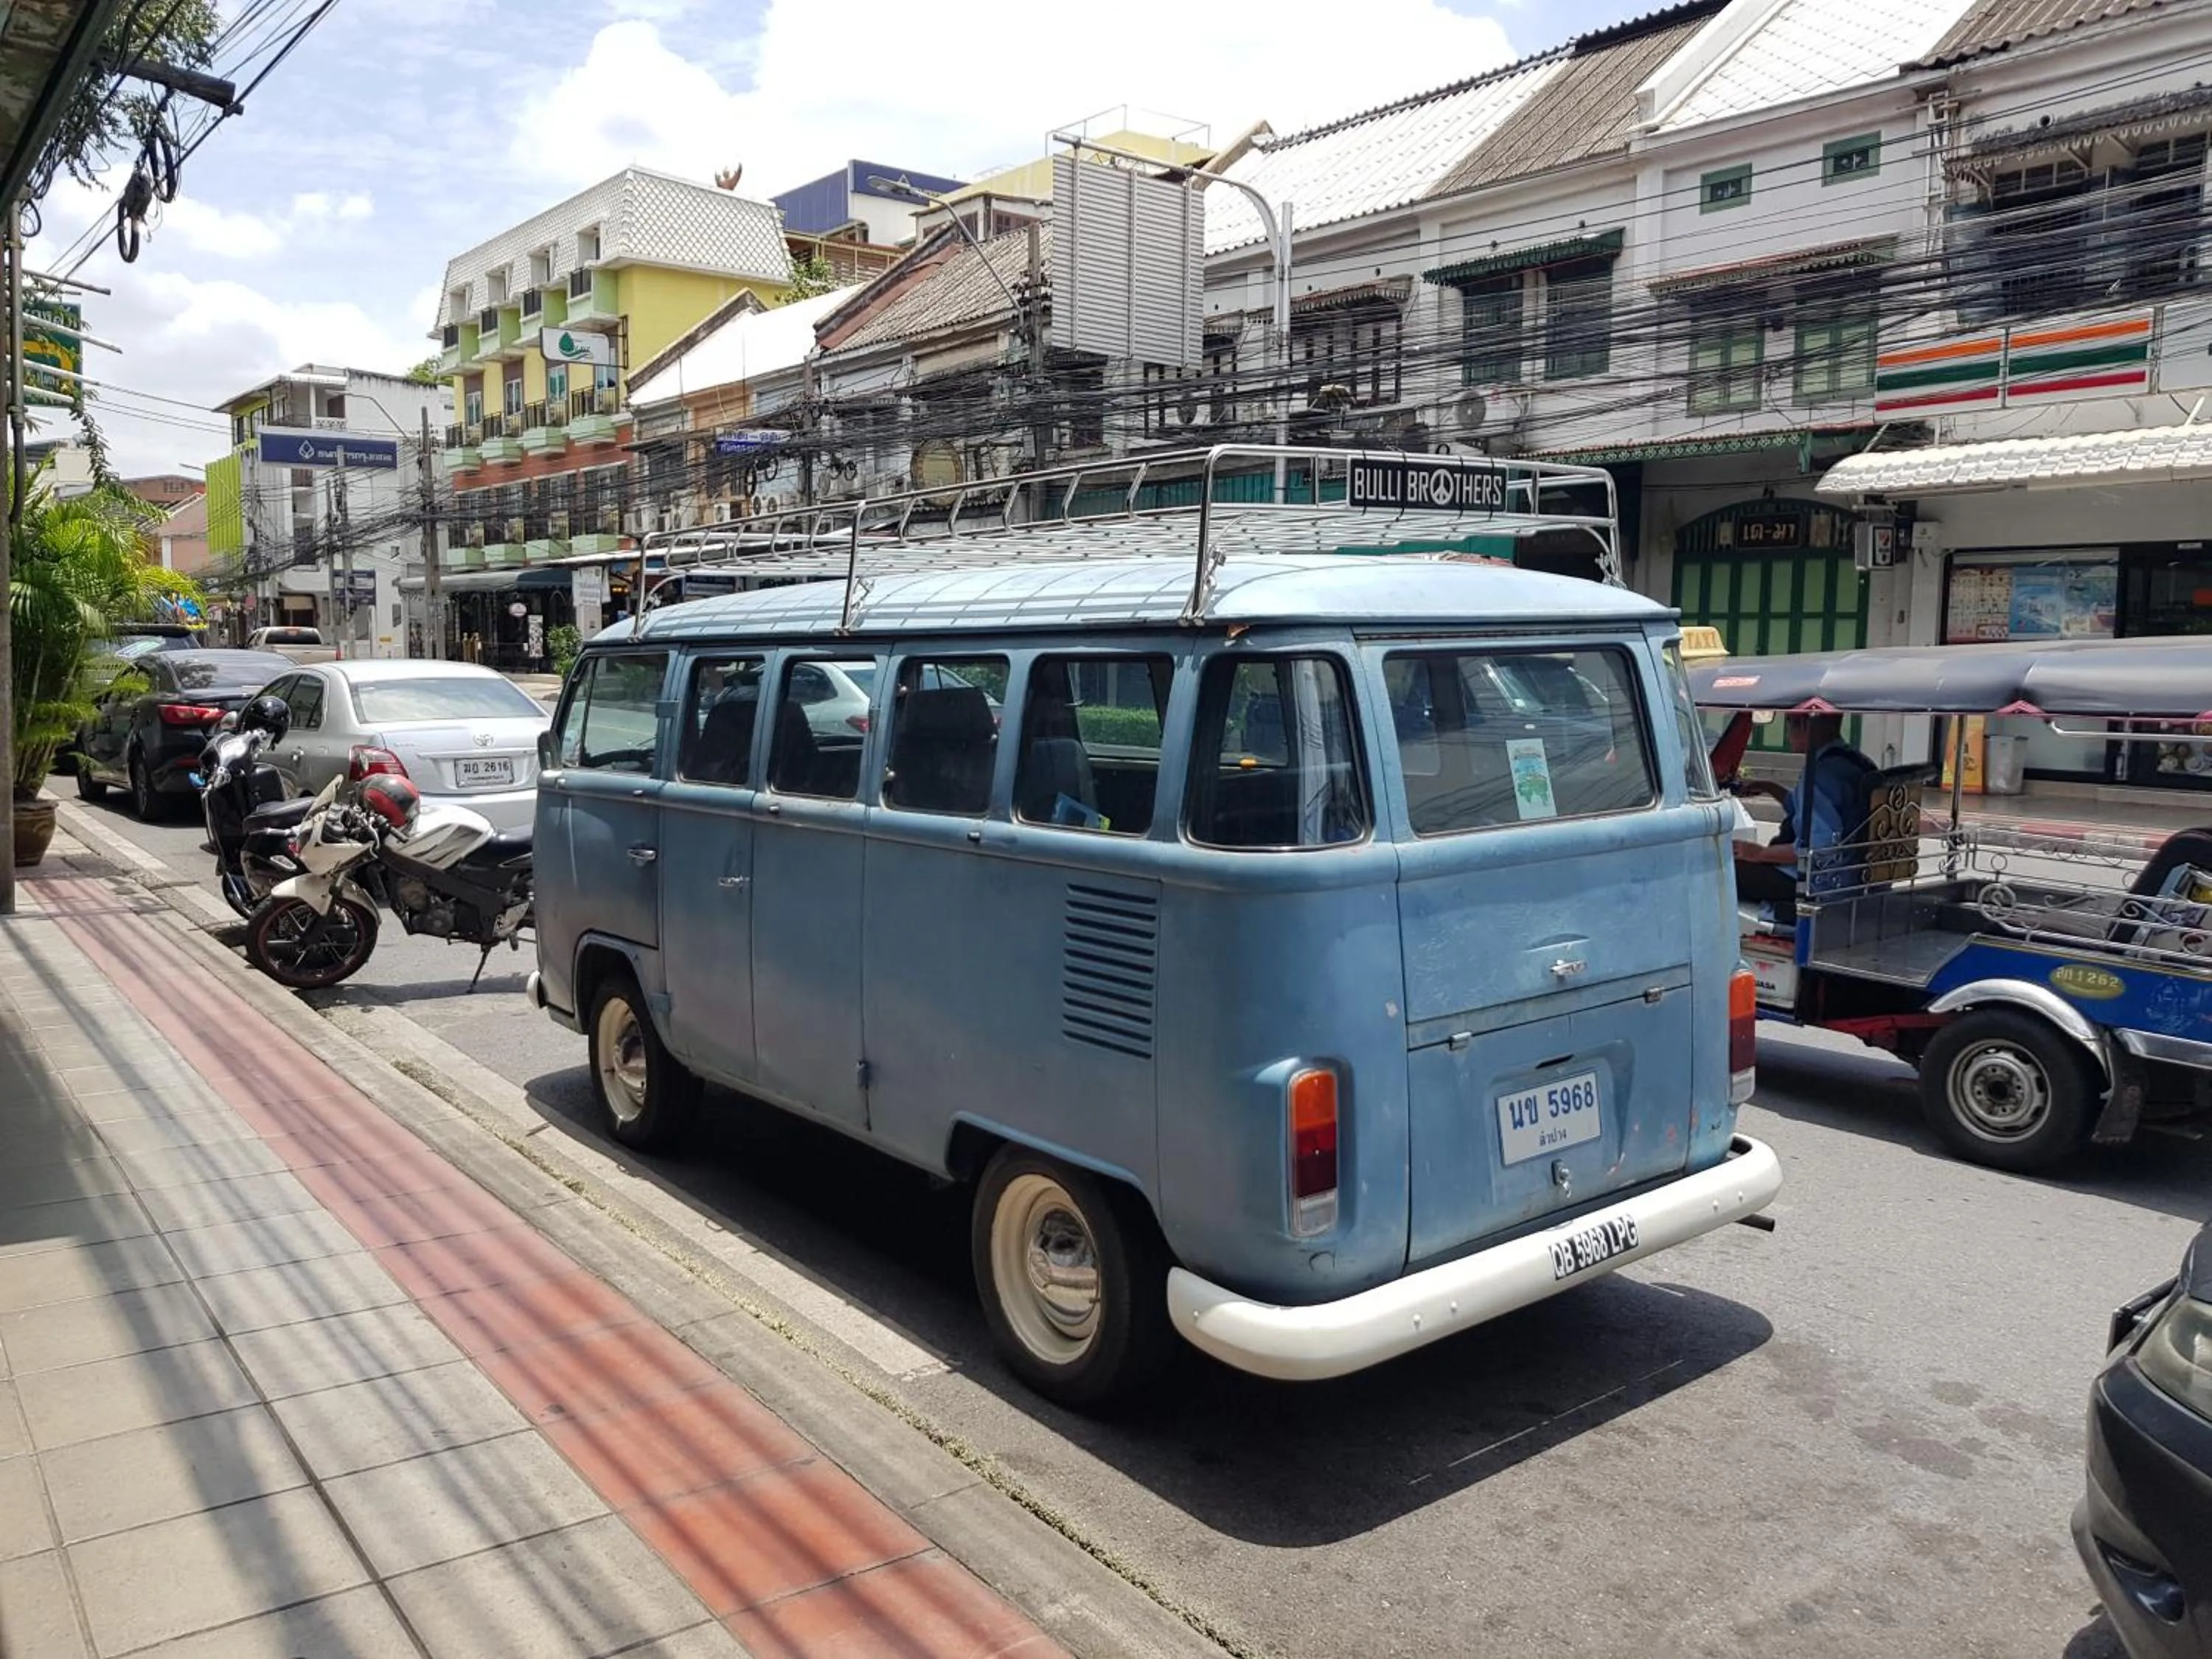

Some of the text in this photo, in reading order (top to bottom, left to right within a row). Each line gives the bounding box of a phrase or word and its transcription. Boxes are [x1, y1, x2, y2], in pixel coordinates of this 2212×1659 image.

[1354, 468, 1502, 505] BULLI BROTHERS
[1686, 632, 1718, 648] TAXI
[1547, 1081, 1593, 1118] 5968
[1573, 1226, 1608, 1267] 5968
[1604, 1214, 1638, 1253] LPG
